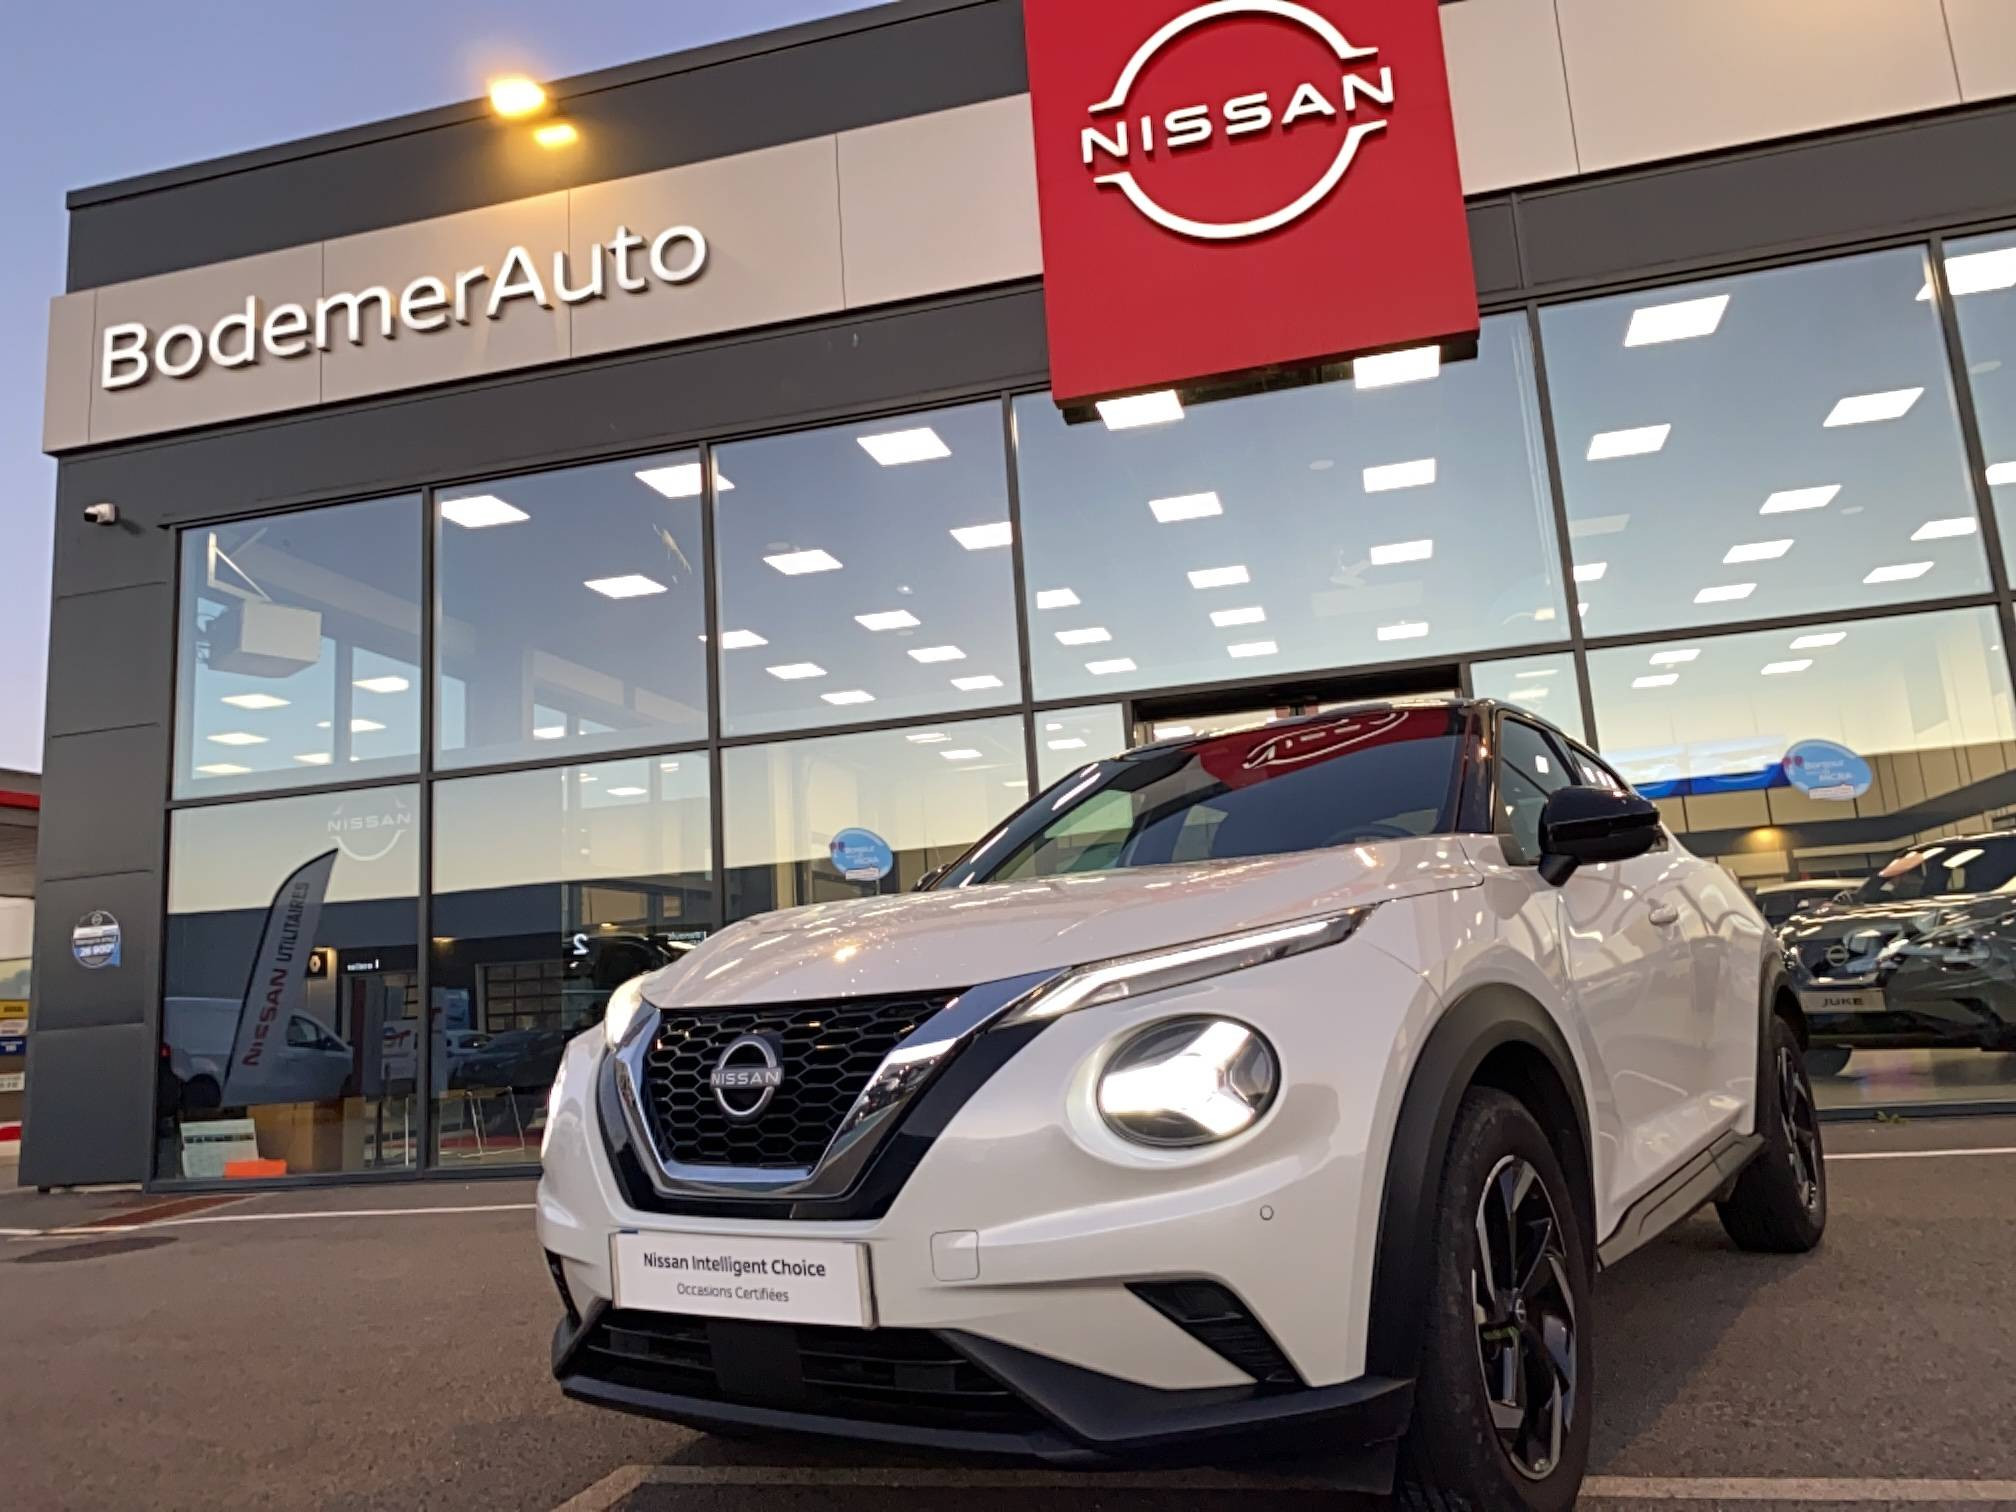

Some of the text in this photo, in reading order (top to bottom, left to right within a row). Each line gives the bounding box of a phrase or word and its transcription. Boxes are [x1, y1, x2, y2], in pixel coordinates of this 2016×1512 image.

[1081, 66, 1394, 164] NISSAN
[101, 224, 708, 390] BodemerAuto
[327, 812, 411, 833] NISSAN
[241, 881, 310, 1068] NISSAN UTILITAIRES
[1822, 997, 1865, 1009] JUKE
[710, 1071, 780, 1086] NISSAN
[643, 1252, 826, 1277] Nissan Intelligent Choice
[676, 1282, 790, 1303] Occasions Certifiées
